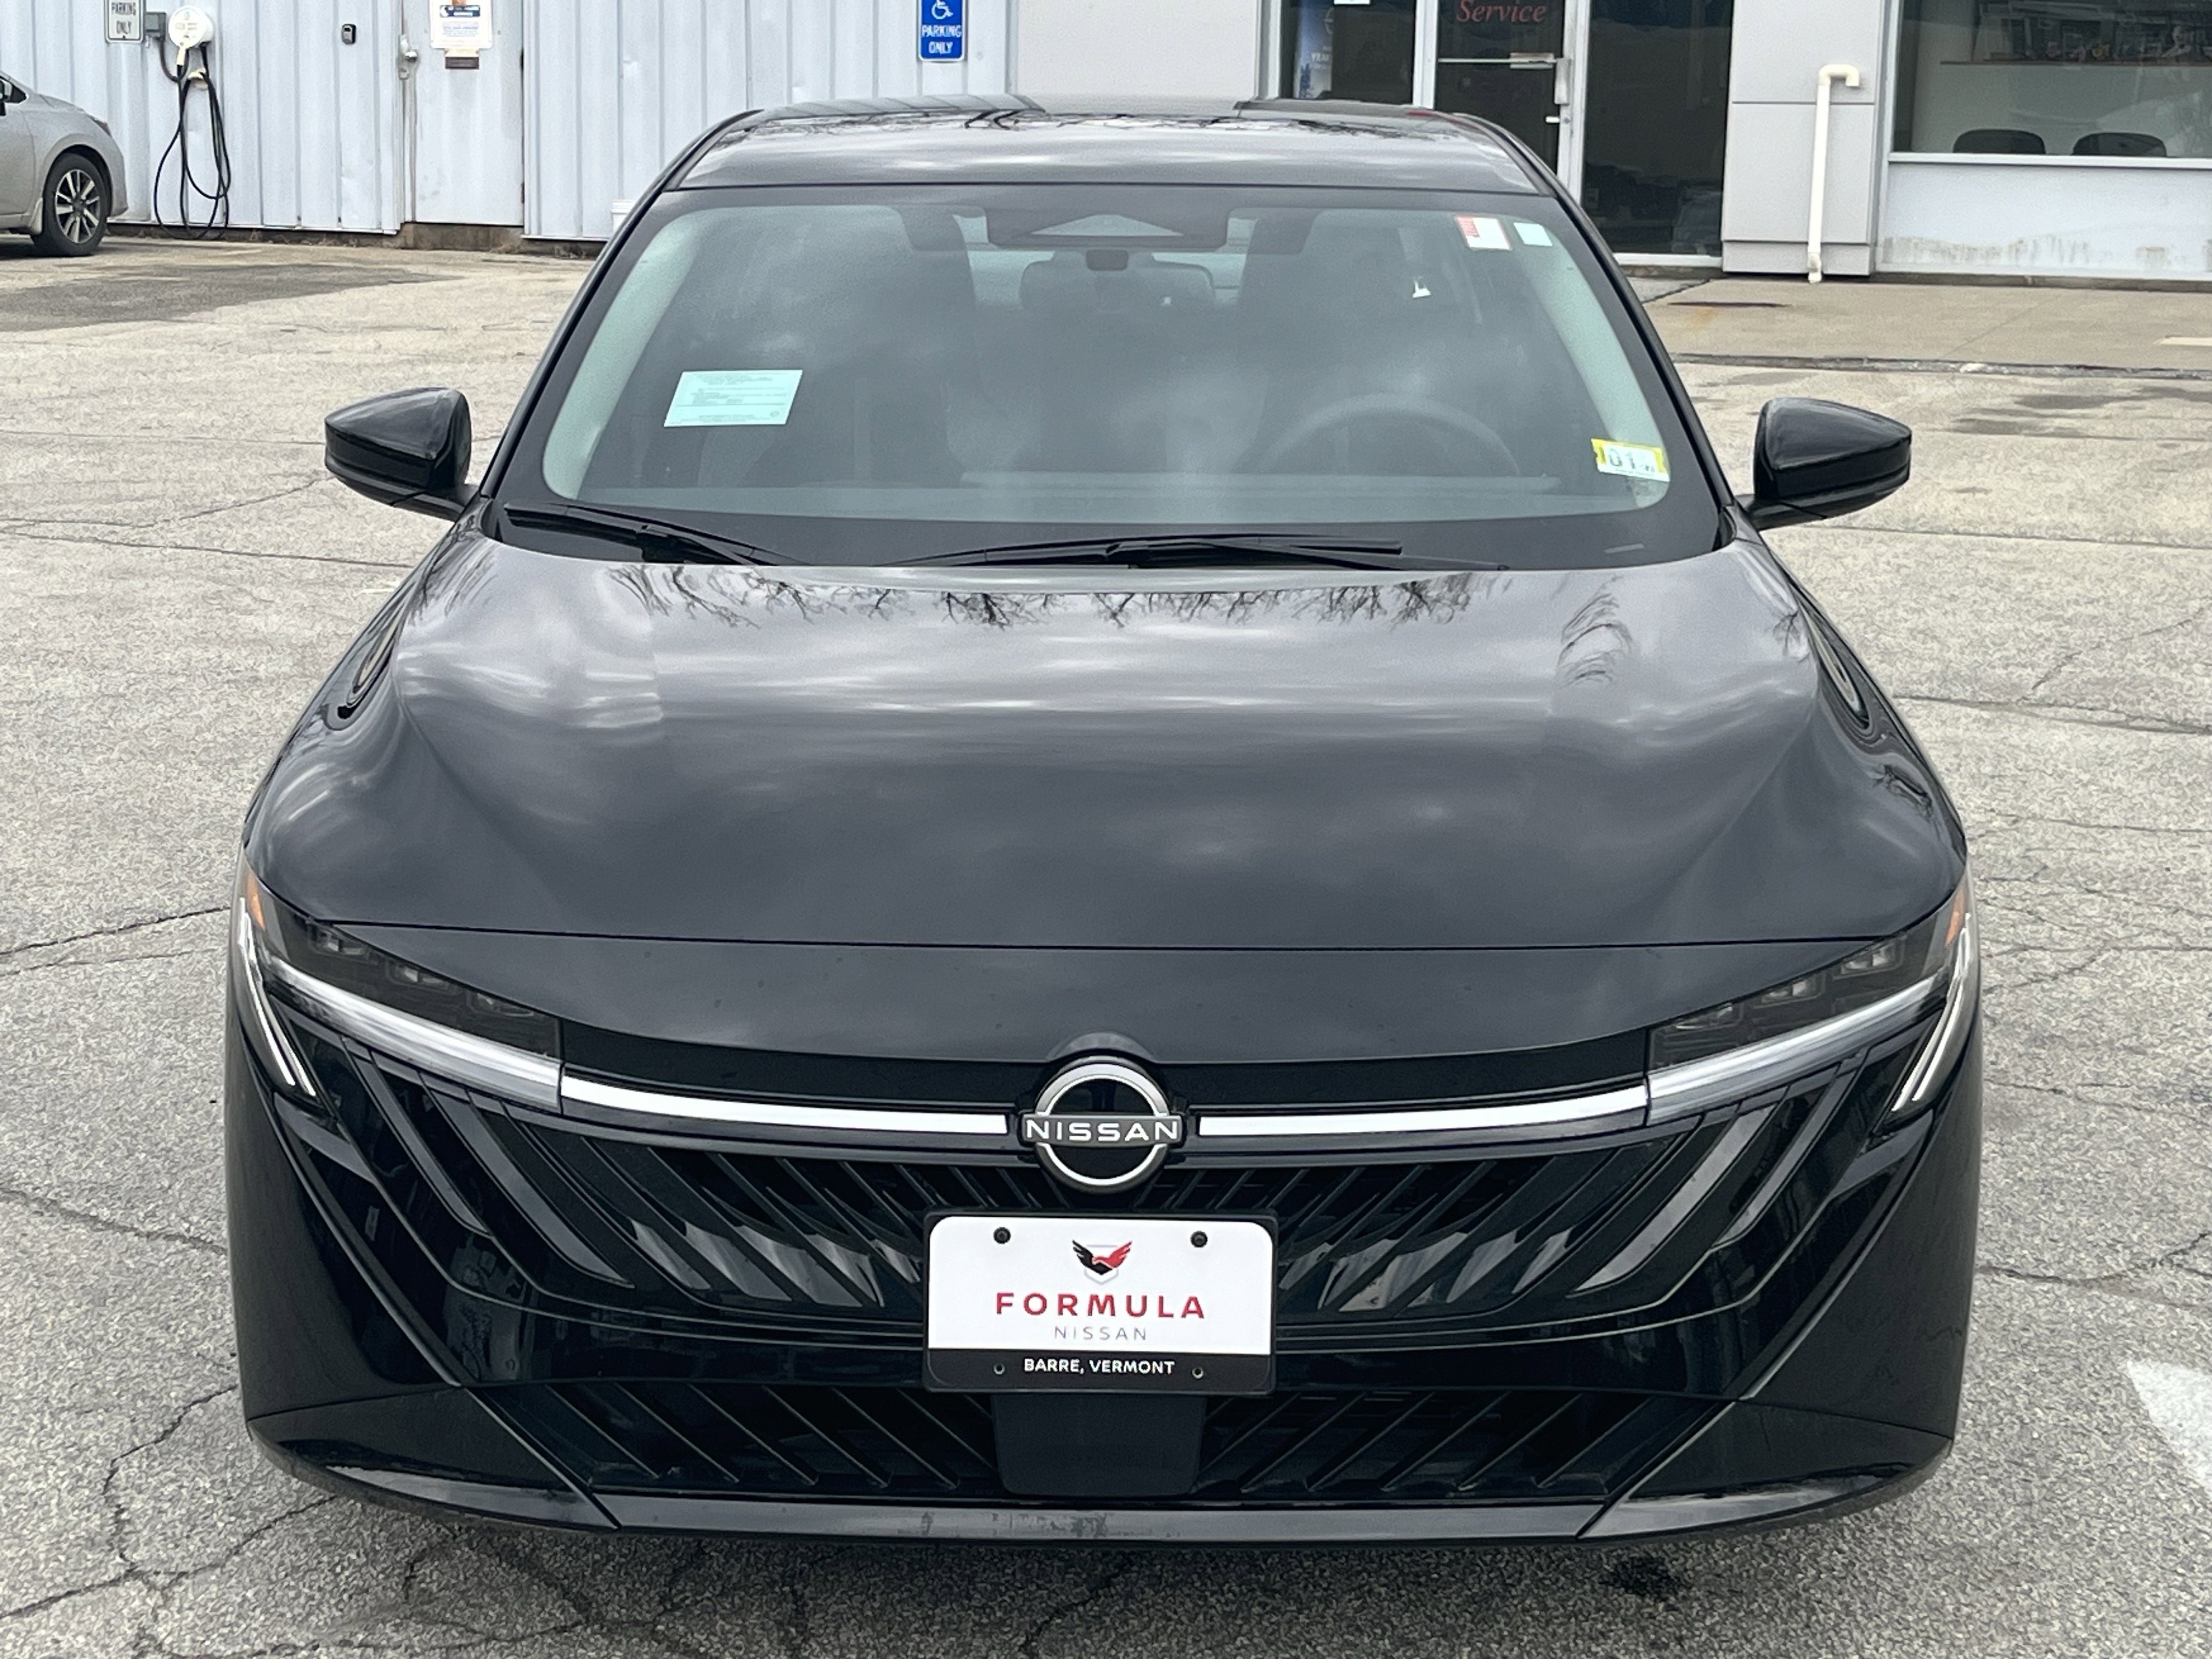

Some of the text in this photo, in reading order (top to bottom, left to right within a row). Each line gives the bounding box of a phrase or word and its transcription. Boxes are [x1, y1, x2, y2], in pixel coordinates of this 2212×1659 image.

[1457, 0, 1546, 22] Service
[922, 25, 962, 37] PARKING
[928, 41, 953, 54] ONLY
[1026, 1119, 1178, 1142] NISSAN
[996, 1292, 1205, 1319] FORMULA
[1054, 1325, 1147, 1341] NISSAN
[1024, 1358, 1175, 1374] BARRE, VERMONT
